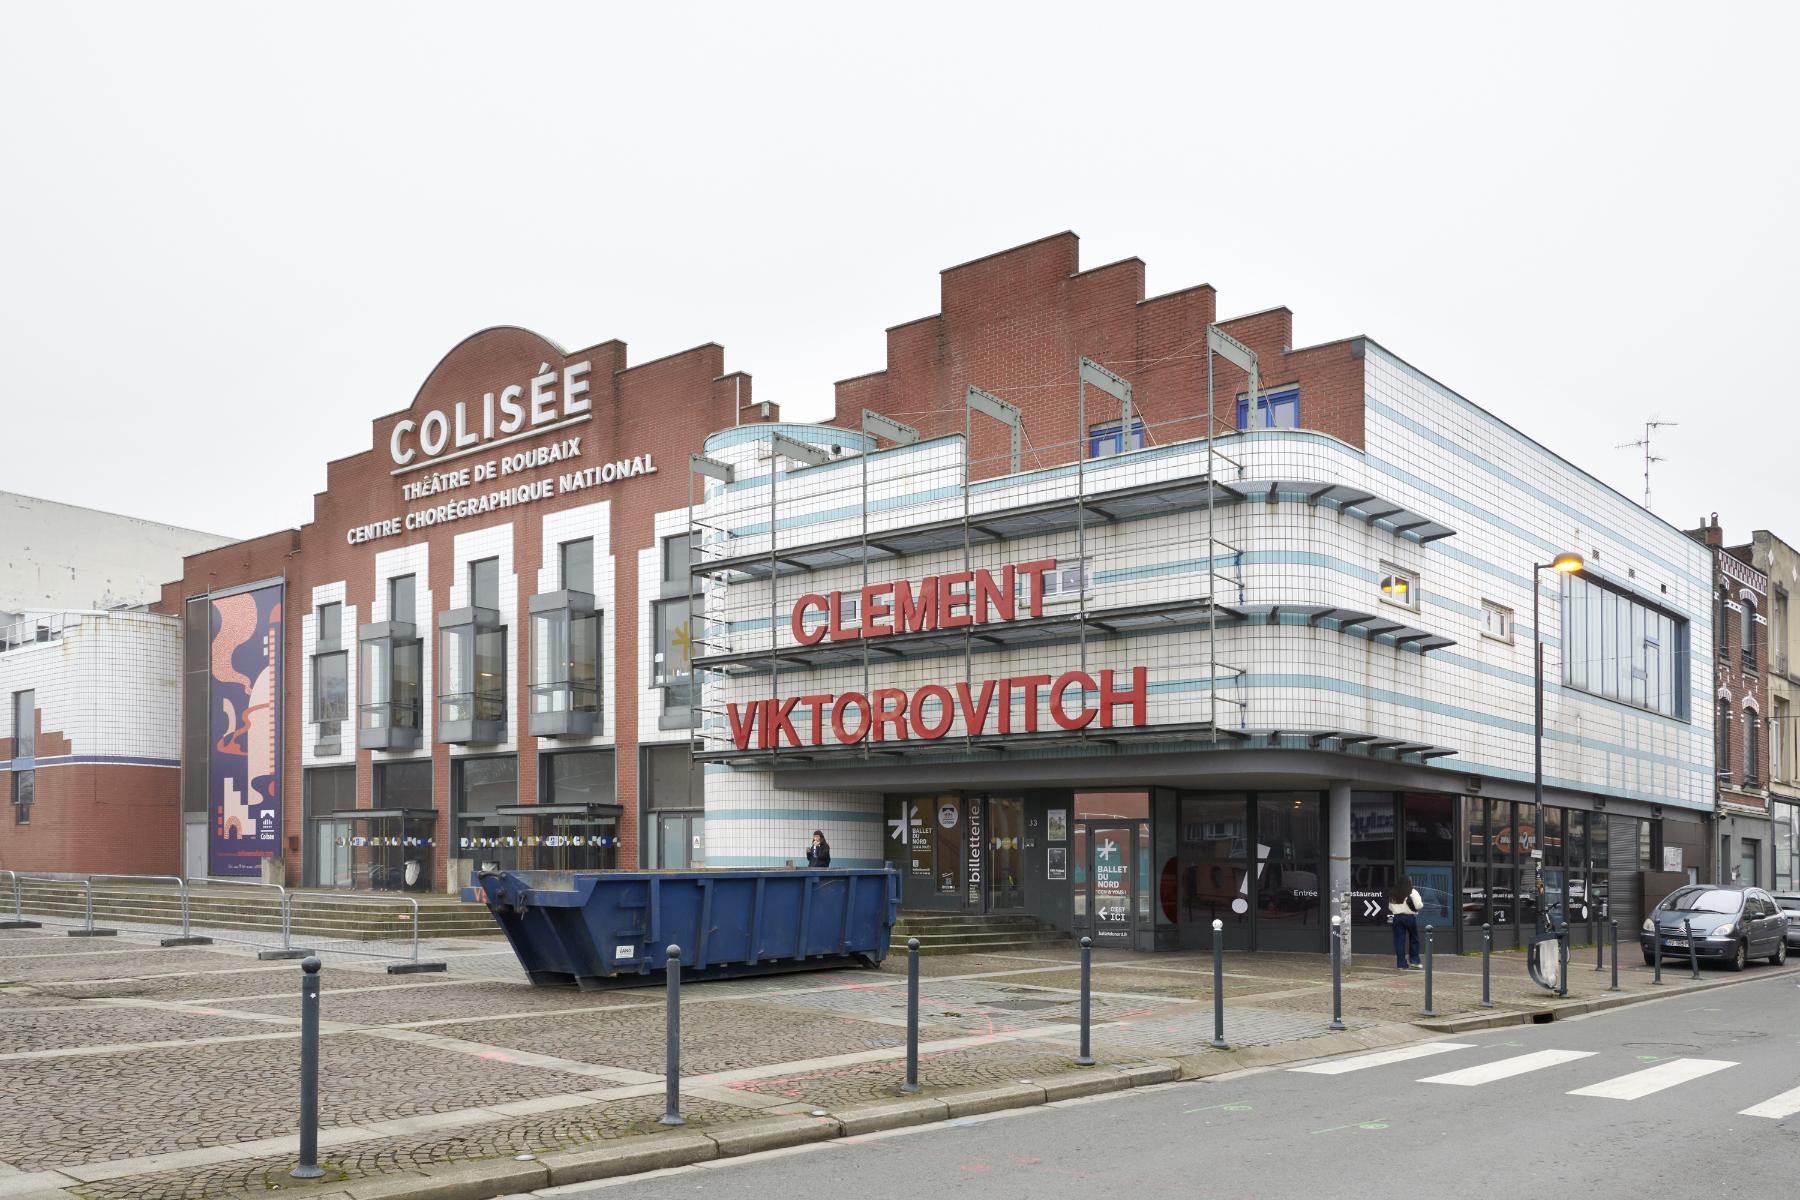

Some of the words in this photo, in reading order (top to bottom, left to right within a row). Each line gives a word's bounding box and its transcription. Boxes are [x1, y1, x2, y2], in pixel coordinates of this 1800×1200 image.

[390, 360, 592, 465] COLISÉE
[347, 517, 402, 545] CENTRE
[405, 478, 554, 531] CHORÉGRAPHIQUE
[559, 454, 657, 494] NATIONAL
[402, 472, 470, 501] THÉÂTRE
[474, 461, 497, 482] DE
[501, 437, 582, 475] ROUBAIX
[791, 558, 1057, 646] CLEMENT
[726, 666, 1147, 751] VIKTOROVITCH
[968, 806, 980, 883] billetterie
[1097, 865, 1128, 873] BALLET
[1097, 873, 1109, 881] DU
[1097, 881, 1120, 889] NORD
[1293, 889, 1318, 897] Entrée
[1110, 913, 1126, 921] ICI
